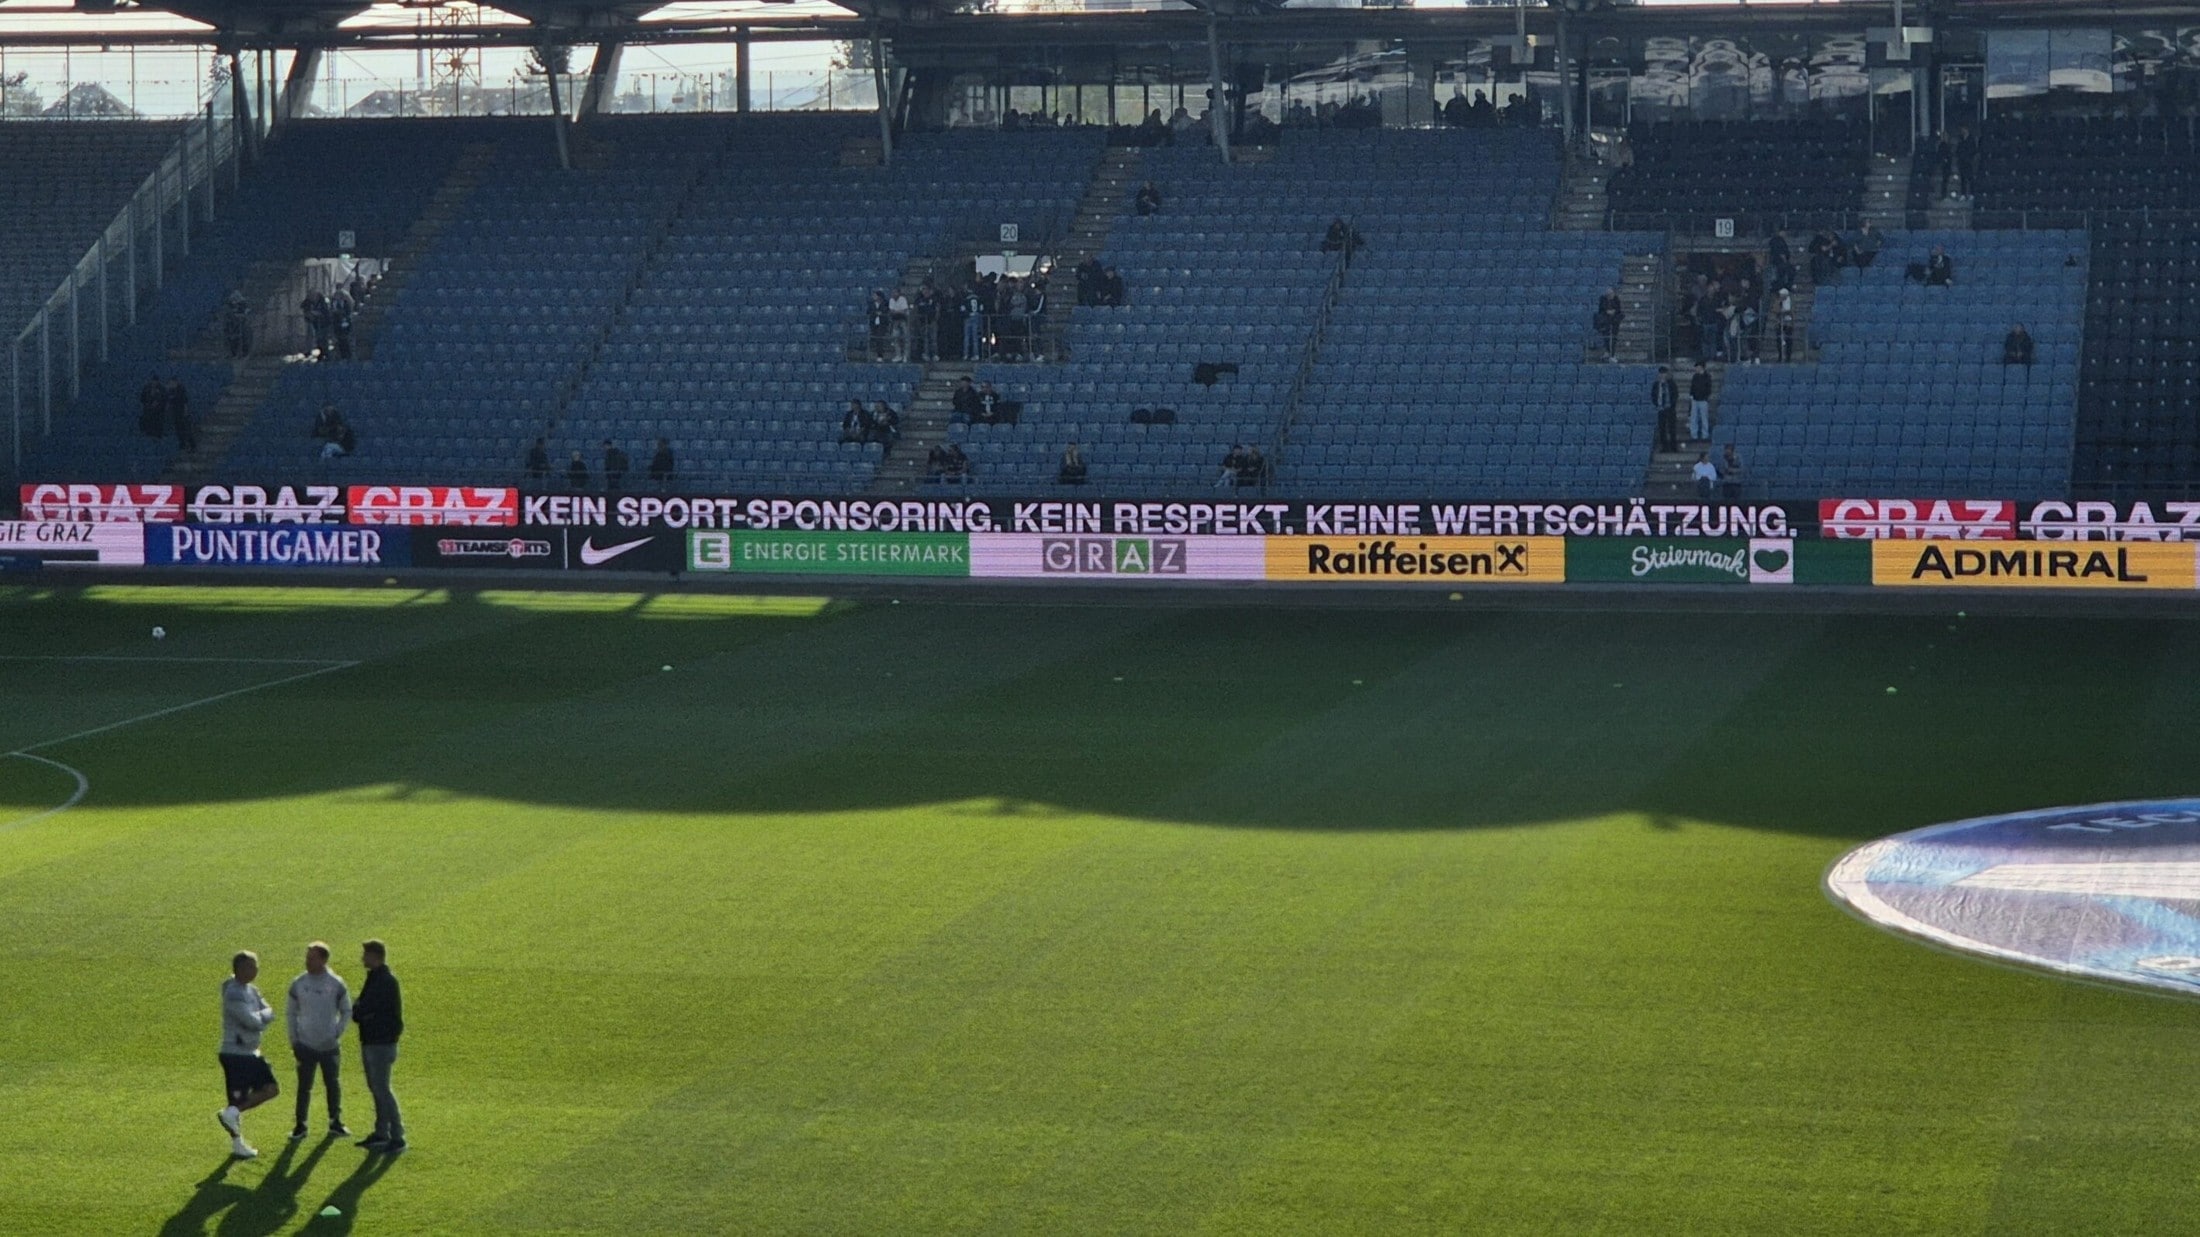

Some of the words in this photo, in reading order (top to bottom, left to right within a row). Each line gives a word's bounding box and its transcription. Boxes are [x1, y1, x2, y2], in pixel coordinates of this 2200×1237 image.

[1002, 225, 1017, 240] 20
[1718, 220, 1732, 235] 19
[29, 483, 175, 522] GRAZ
[193, 485, 342, 524] GRAZ
[361, 486, 508, 526] GRAZ
[524, 495, 607, 526] KEIN
[616, 496, 1001, 532] SPORT-SPONSORING.
[1013, 503, 1101, 533] KEIN
[1113, 503, 1294, 535] RESPEKT.
[1306, 504, 1421, 535] KEINE
[1431, 497, 1798, 537] WERTSCHÄTZUNG.
[1832, 500, 2006, 539] GRAZ
[36, 522, 95, 542] GRAZ
[172, 526, 381, 564] PUNTIGAMER
[743, 541, 827, 560] ENERGIE
[837, 543, 963, 563] STEIERMARK
[1045, 540, 1184, 572] GRAZ
[1308, 541, 1492, 575] Raiffeisen
[1631, 545, 1747, 577] Steiermark
[1911, 545, 2147, 581] ADMIRAL
[2046, 811, 2200, 832] TEC
